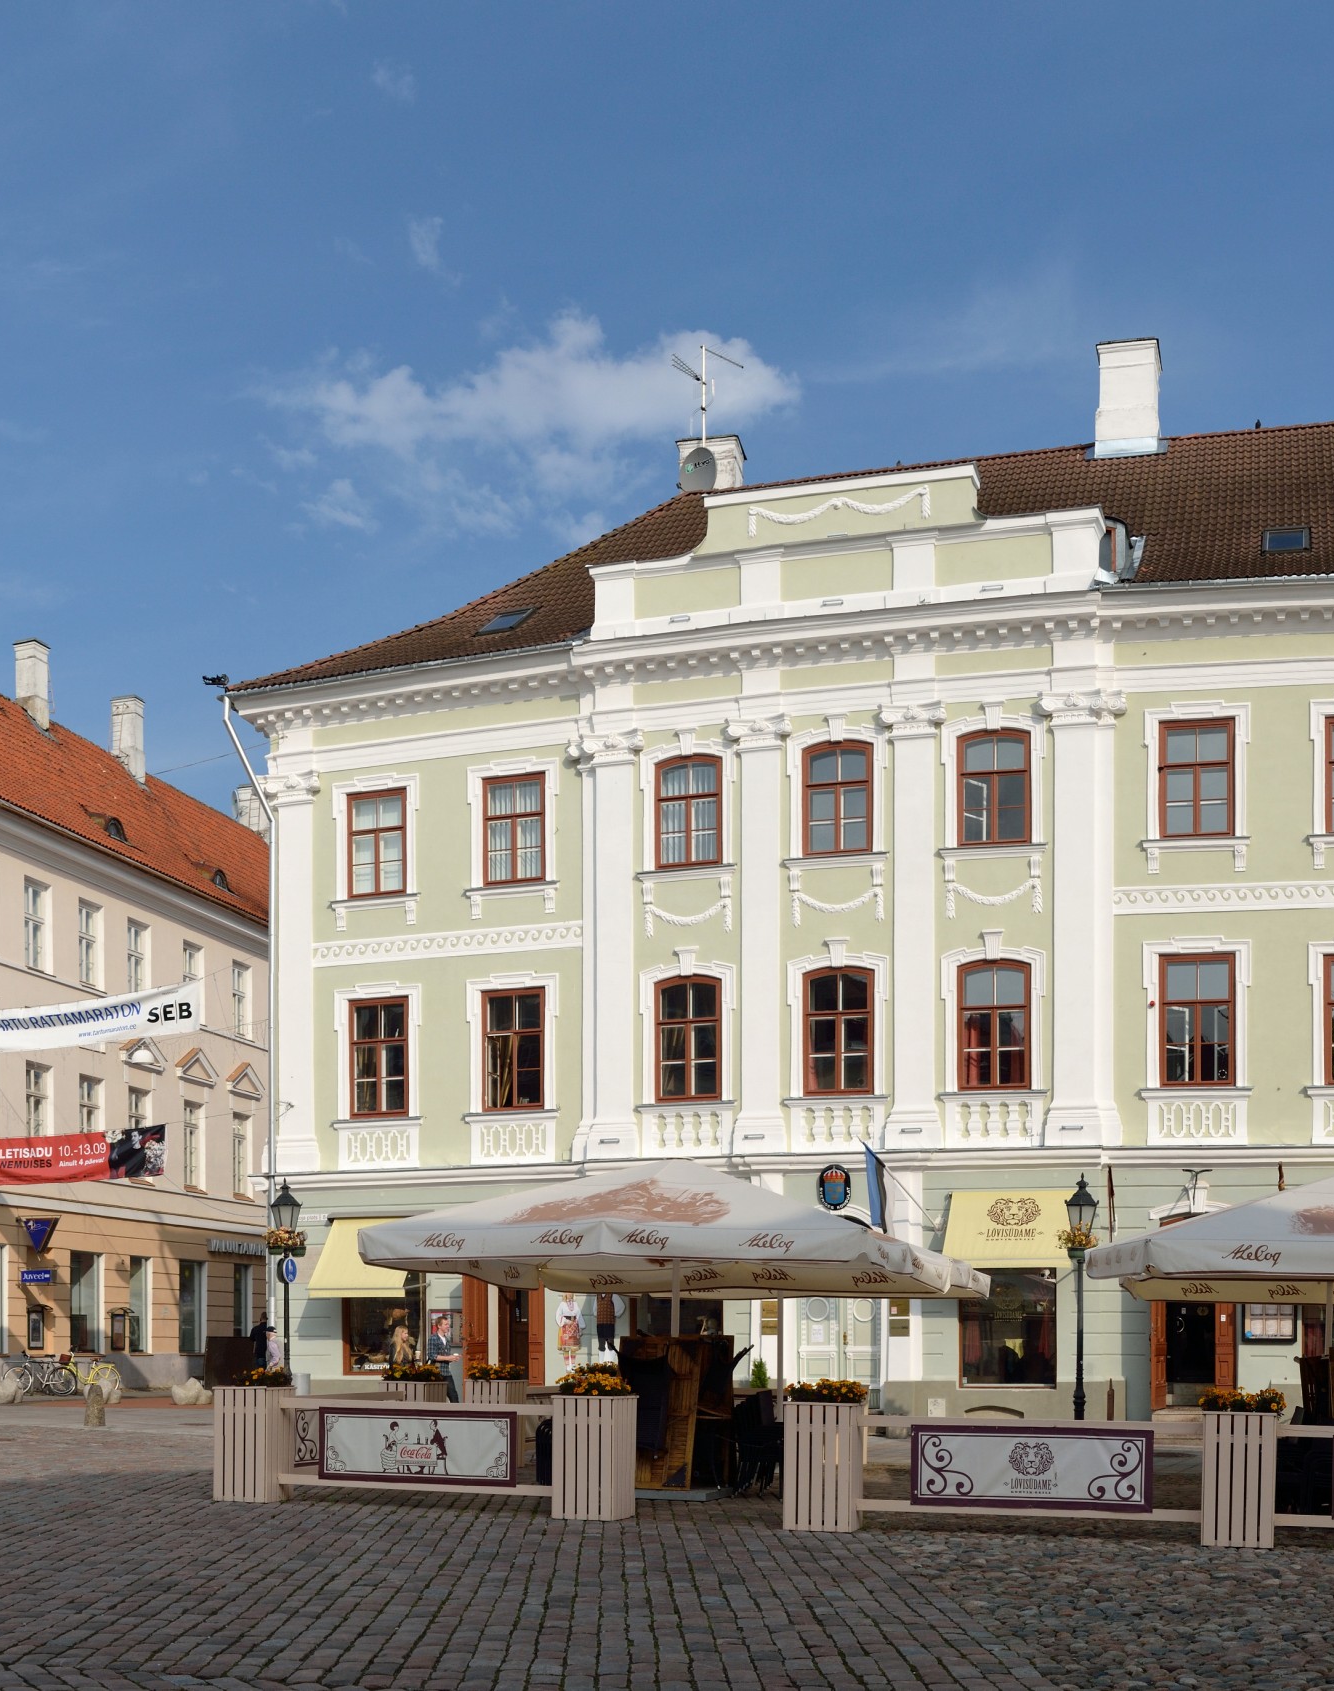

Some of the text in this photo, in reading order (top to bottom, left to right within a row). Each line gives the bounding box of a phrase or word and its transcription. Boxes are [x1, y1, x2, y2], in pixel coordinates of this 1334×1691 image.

[28, 1000, 142, 1029] RATTAMARATON
[78, 1023, 137, 1038] www.tartumaraton.ee
[58, 1142, 107, 1158] 10.-13.09
[59, 1160, 77, 1168] Ainult
[986, 1227, 1037, 1238] LÕVISÜDAME
[23, 1272, 45, 1281] Juveel
[1010, 1477, 1052, 1491] LÕVISÜDAME
